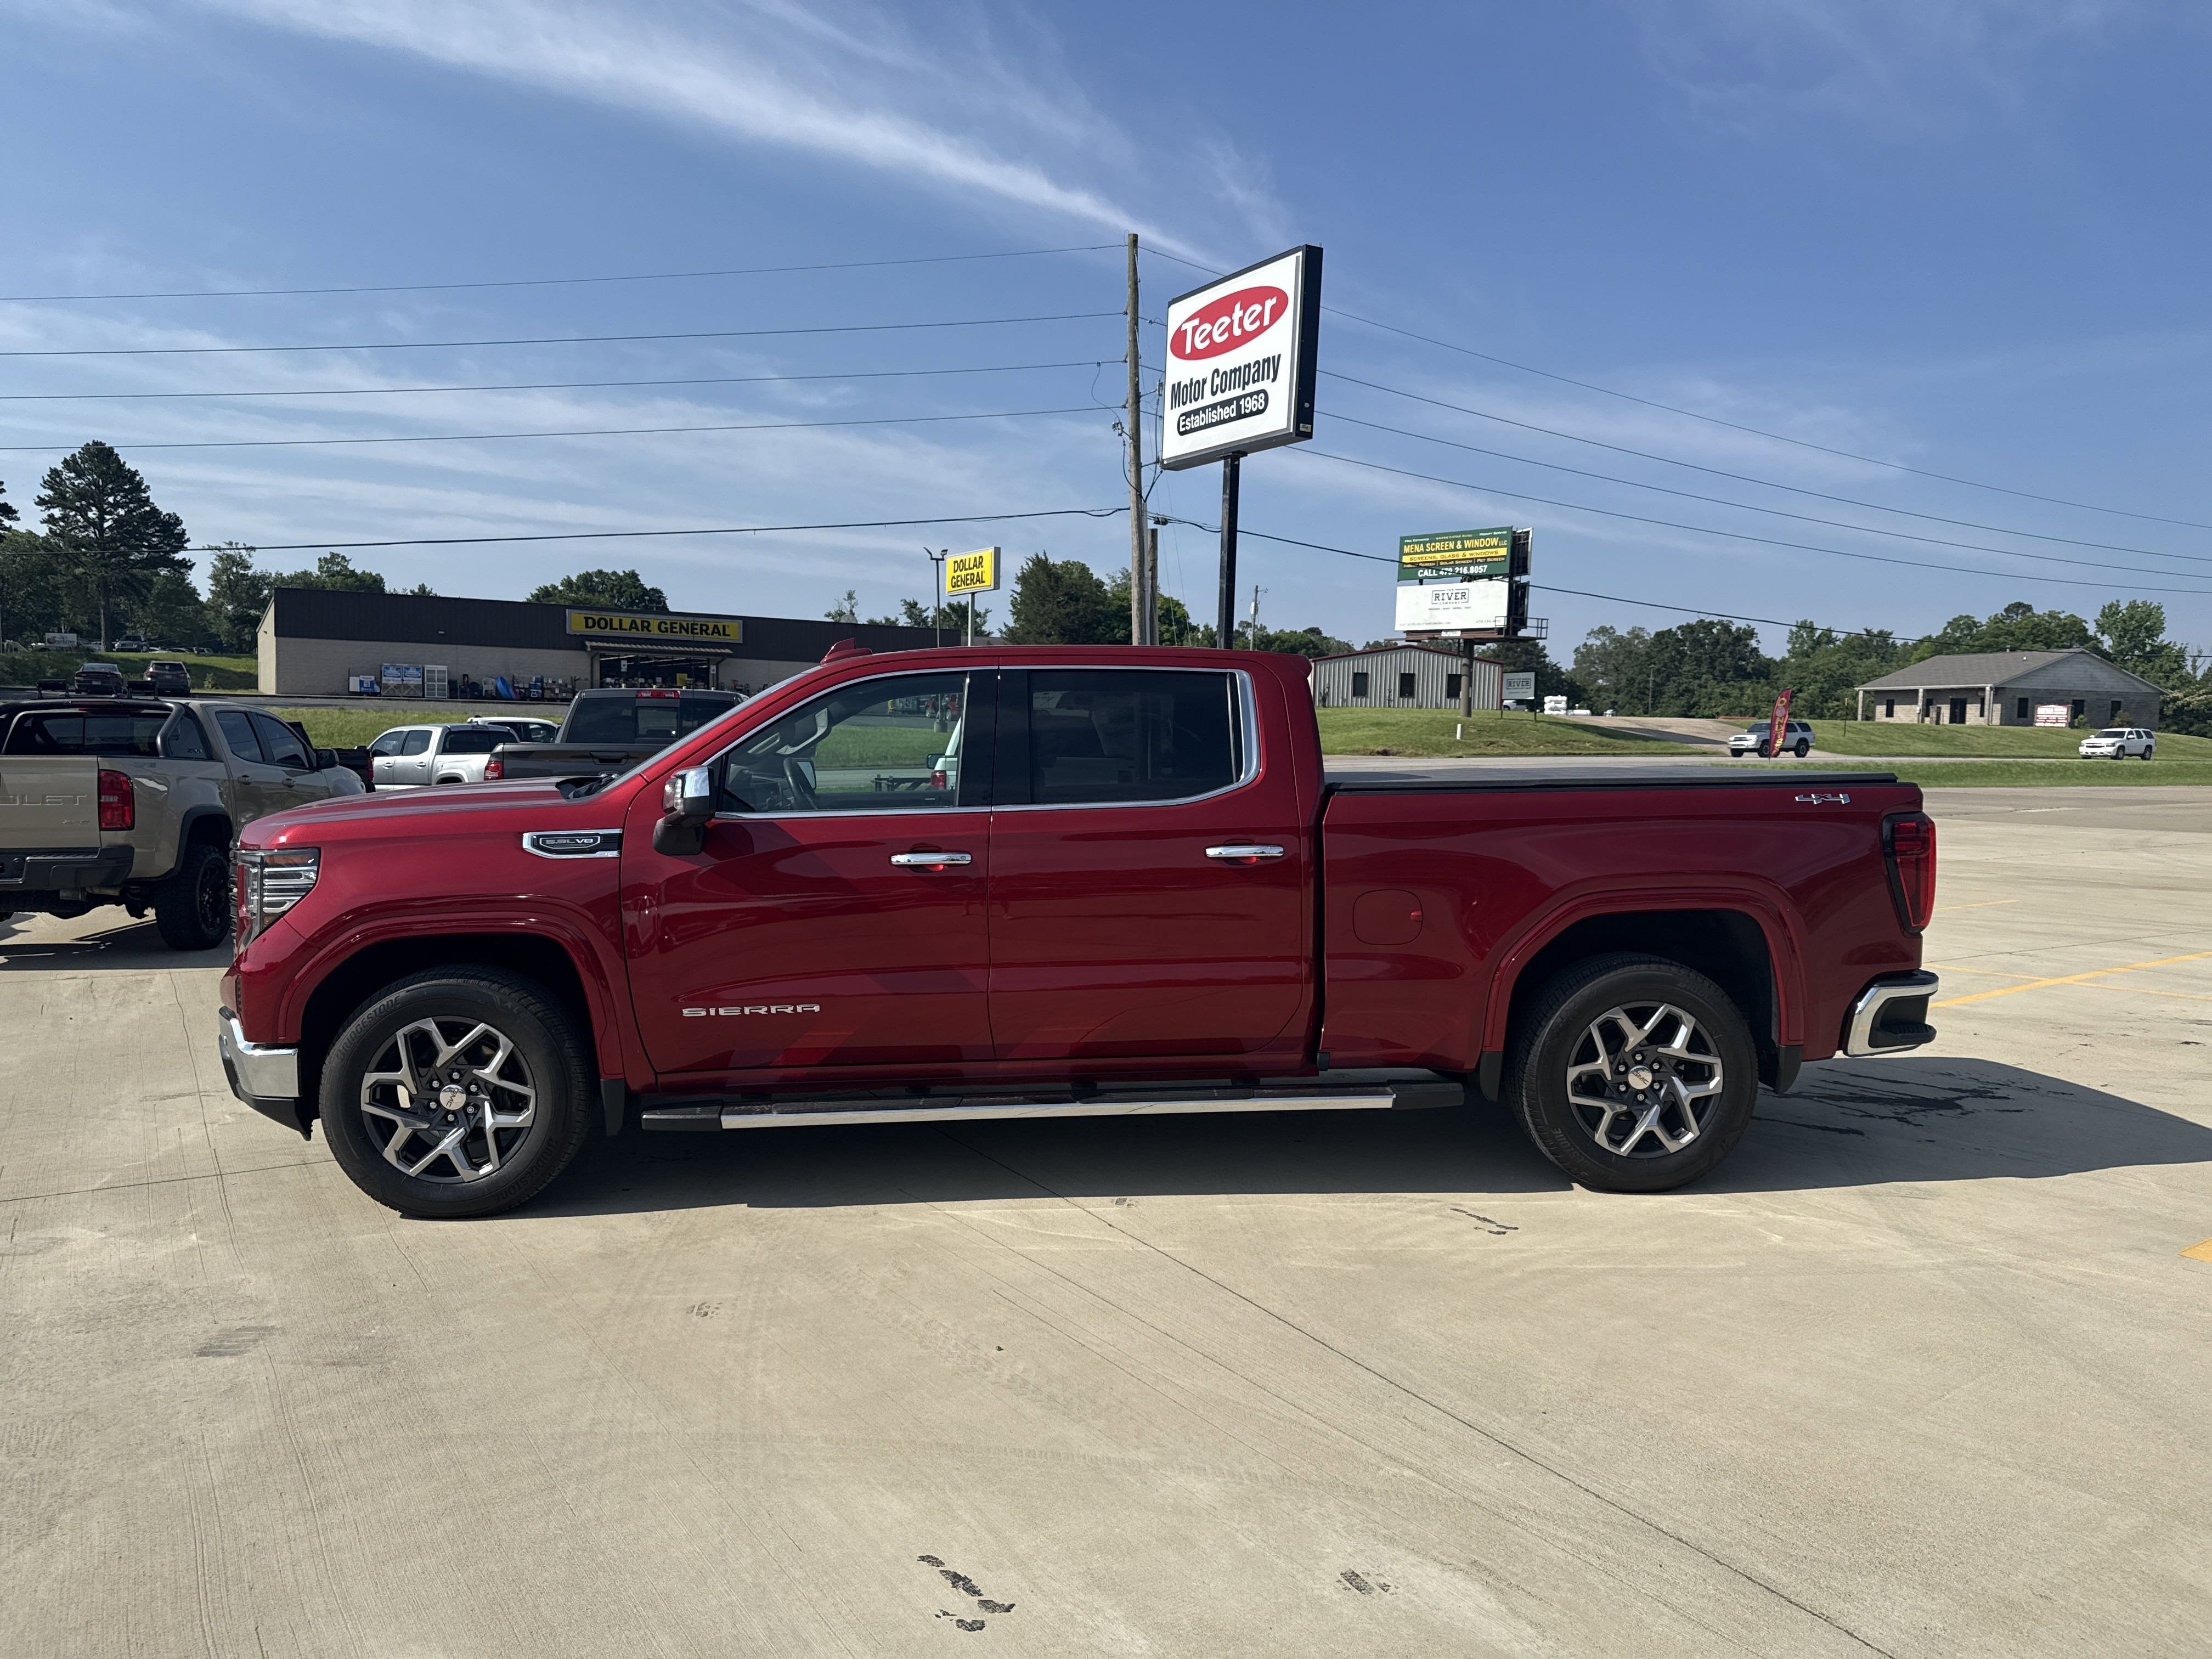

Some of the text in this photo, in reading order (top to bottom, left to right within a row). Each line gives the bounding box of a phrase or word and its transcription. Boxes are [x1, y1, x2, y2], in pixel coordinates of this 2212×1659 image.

[1181, 296, 1277, 355] Teeter
[1170, 354, 1282, 410] Motor Company
[1180, 393, 1265, 432] Established 1968
[1403, 543, 1424, 554] MENA
[1426, 541, 1454, 552] SCREEN
[1456, 540, 1462, 549] &
[1464, 537, 1499, 549] WINDOW
[953, 555, 984, 573] DOLLAR
[1418, 569, 1438, 577] CALL
[951, 571, 985, 589] GENERAL
[1434, 591, 1466, 601] RIVER
[584, 616, 731, 637] DOLLAR GENERAL
[1795, 793, 1850, 805] 4X4
[682, 1004, 820, 1017] SIERRA
[1632, 1070, 1650, 1086] GMC
[445, 1087, 460, 1108] GMC
